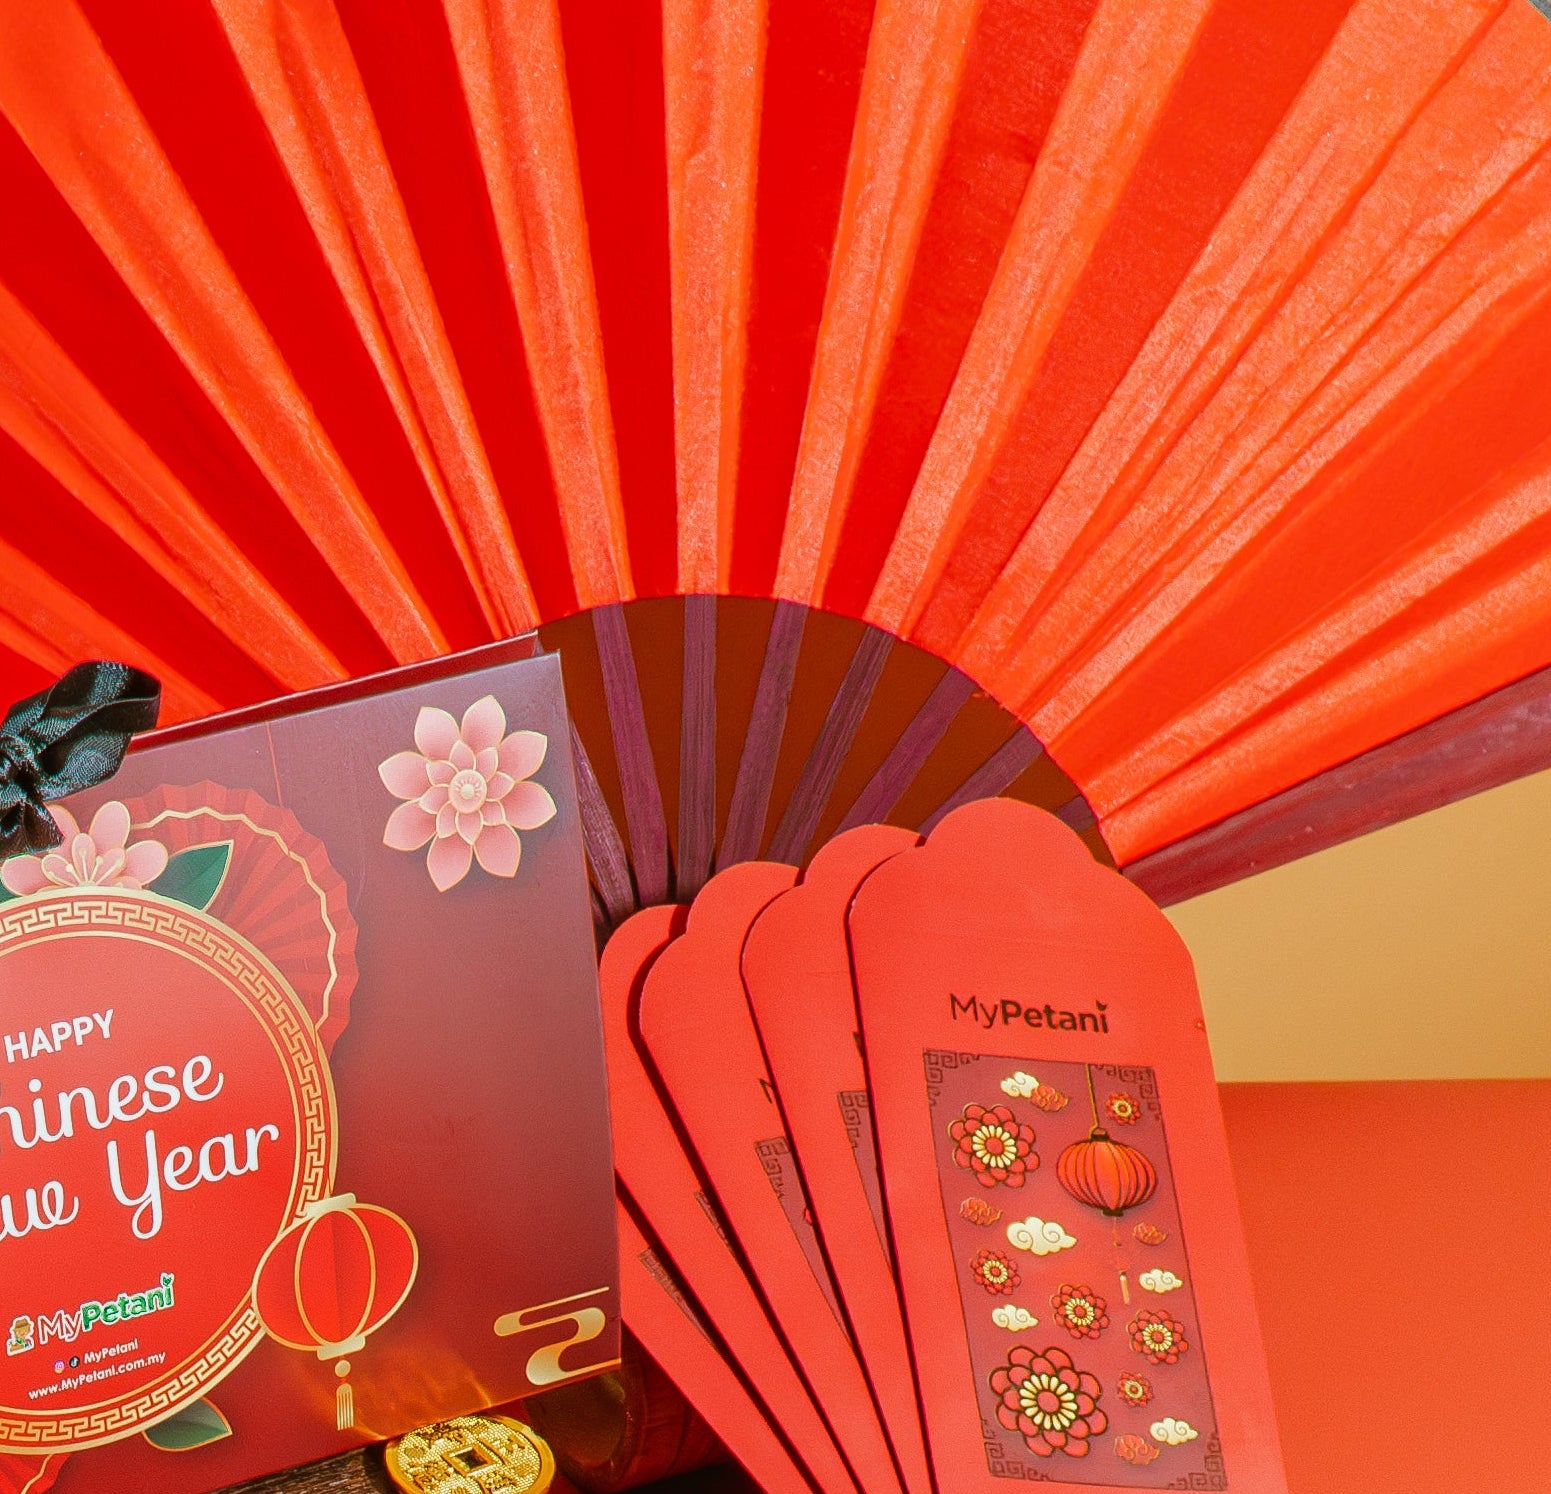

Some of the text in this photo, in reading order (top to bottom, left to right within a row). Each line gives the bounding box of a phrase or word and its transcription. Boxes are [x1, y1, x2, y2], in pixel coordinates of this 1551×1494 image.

[3, 1009, 115, 1063] HAPPY
[950, 993, 1109, 1034] MyPetani
[107, 1121, 280, 1240] Year
[37, 1272, 175, 1345] MyPetani
[27, 1351, 167, 1400] www.MyPetani.com.my
[84, 1338, 139, 1365] MyPetani
